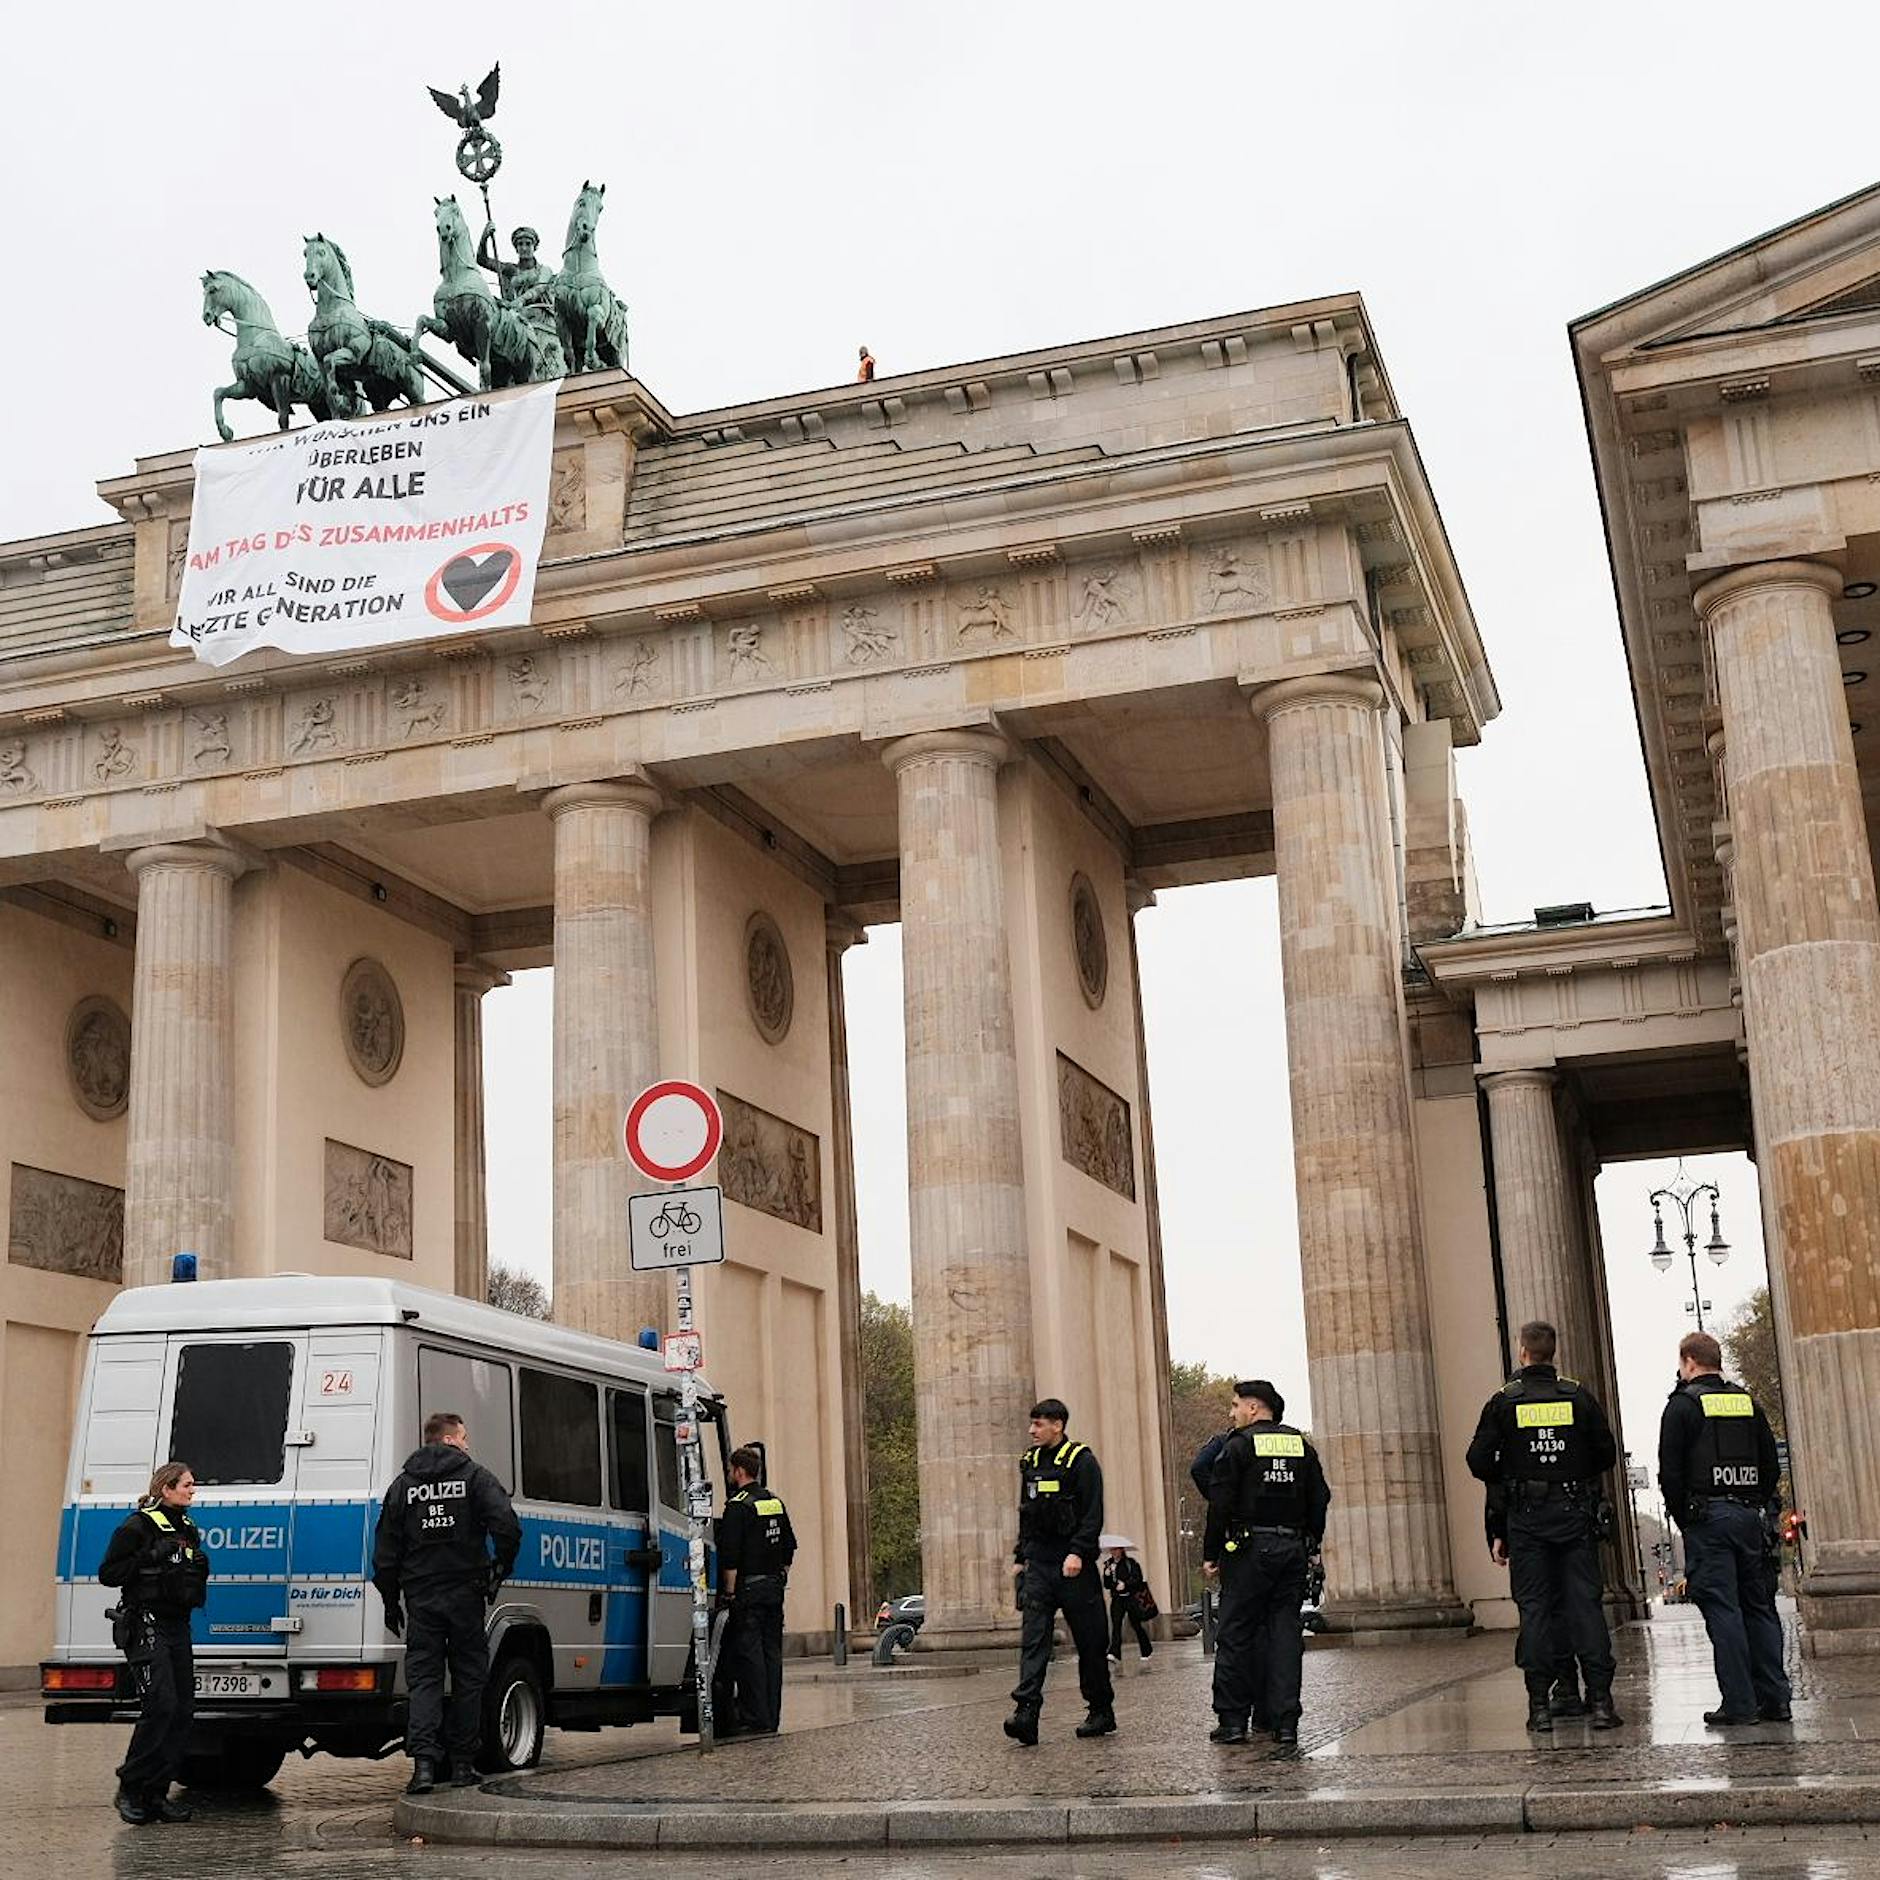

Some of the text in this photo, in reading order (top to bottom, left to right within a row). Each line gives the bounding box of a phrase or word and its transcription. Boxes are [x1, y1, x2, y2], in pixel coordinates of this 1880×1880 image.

[458, 403, 491, 423] EIN
[352, 471, 426, 501] ALLE
[190, 501, 529, 571] AM TAG DS ZUSAMMENHALTS
[241, 581, 279, 601] ALL
[285, 570, 336, 595] SIND
[341, 574, 377, 592] DIE
[177, 592, 405, 644] LEZTE GNERATION
[663, 1239, 692, 1259] frei
[323, 1373, 350, 1392] 24
[1519, 1405, 1570, 1425] POLIZEI
[1538, 1428, 1555, 1440] BE
[1257, 1436, 1302, 1454] POLIZEI
[1529, 1440, 1566, 1452] 14130
[1272, 1458, 1288, 1470] BE
[1712, 1465, 1759, 1486] POLIZEI
[407, 1480, 467, 1504] POLIZEI
[428, 1504, 445, 1517] BE
[540, 1532, 605, 1571] POLIZEI
[290, 1587, 362, 1600] Da für Dich
[212, 1676, 248, 1692] 7398
